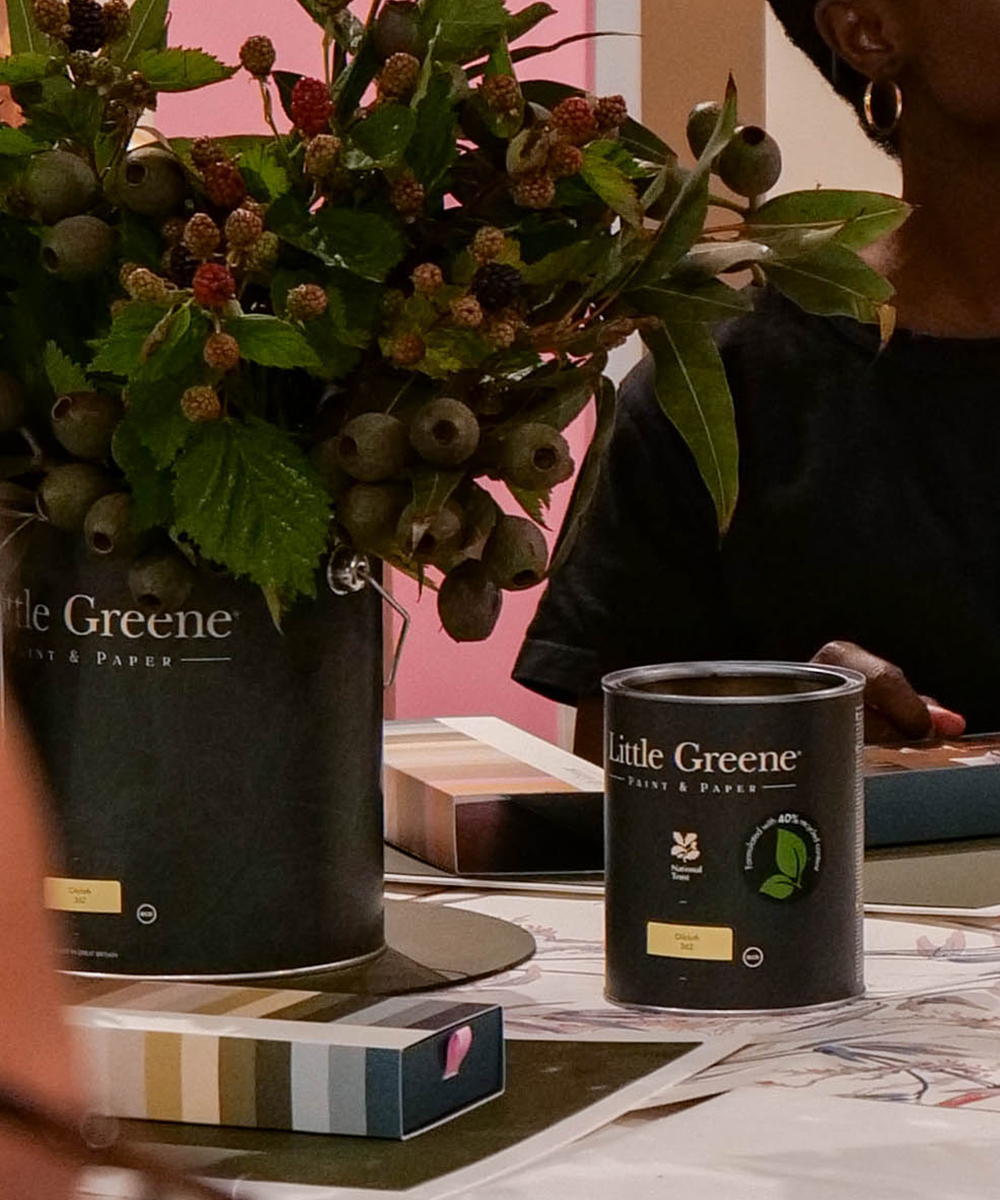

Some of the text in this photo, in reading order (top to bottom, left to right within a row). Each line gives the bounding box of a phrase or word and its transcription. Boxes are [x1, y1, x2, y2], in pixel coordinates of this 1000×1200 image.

[64, 594, 233, 639] Greene
[69, 650, 79, 664] &
[97, 651, 173, 667] PAPER
[609, 731, 797, 773] Little Greene
[628, 776, 757, 793] PAINT & PAPER
[778, 813, 800, 825] 40%
[670, 864, 703, 874] National
